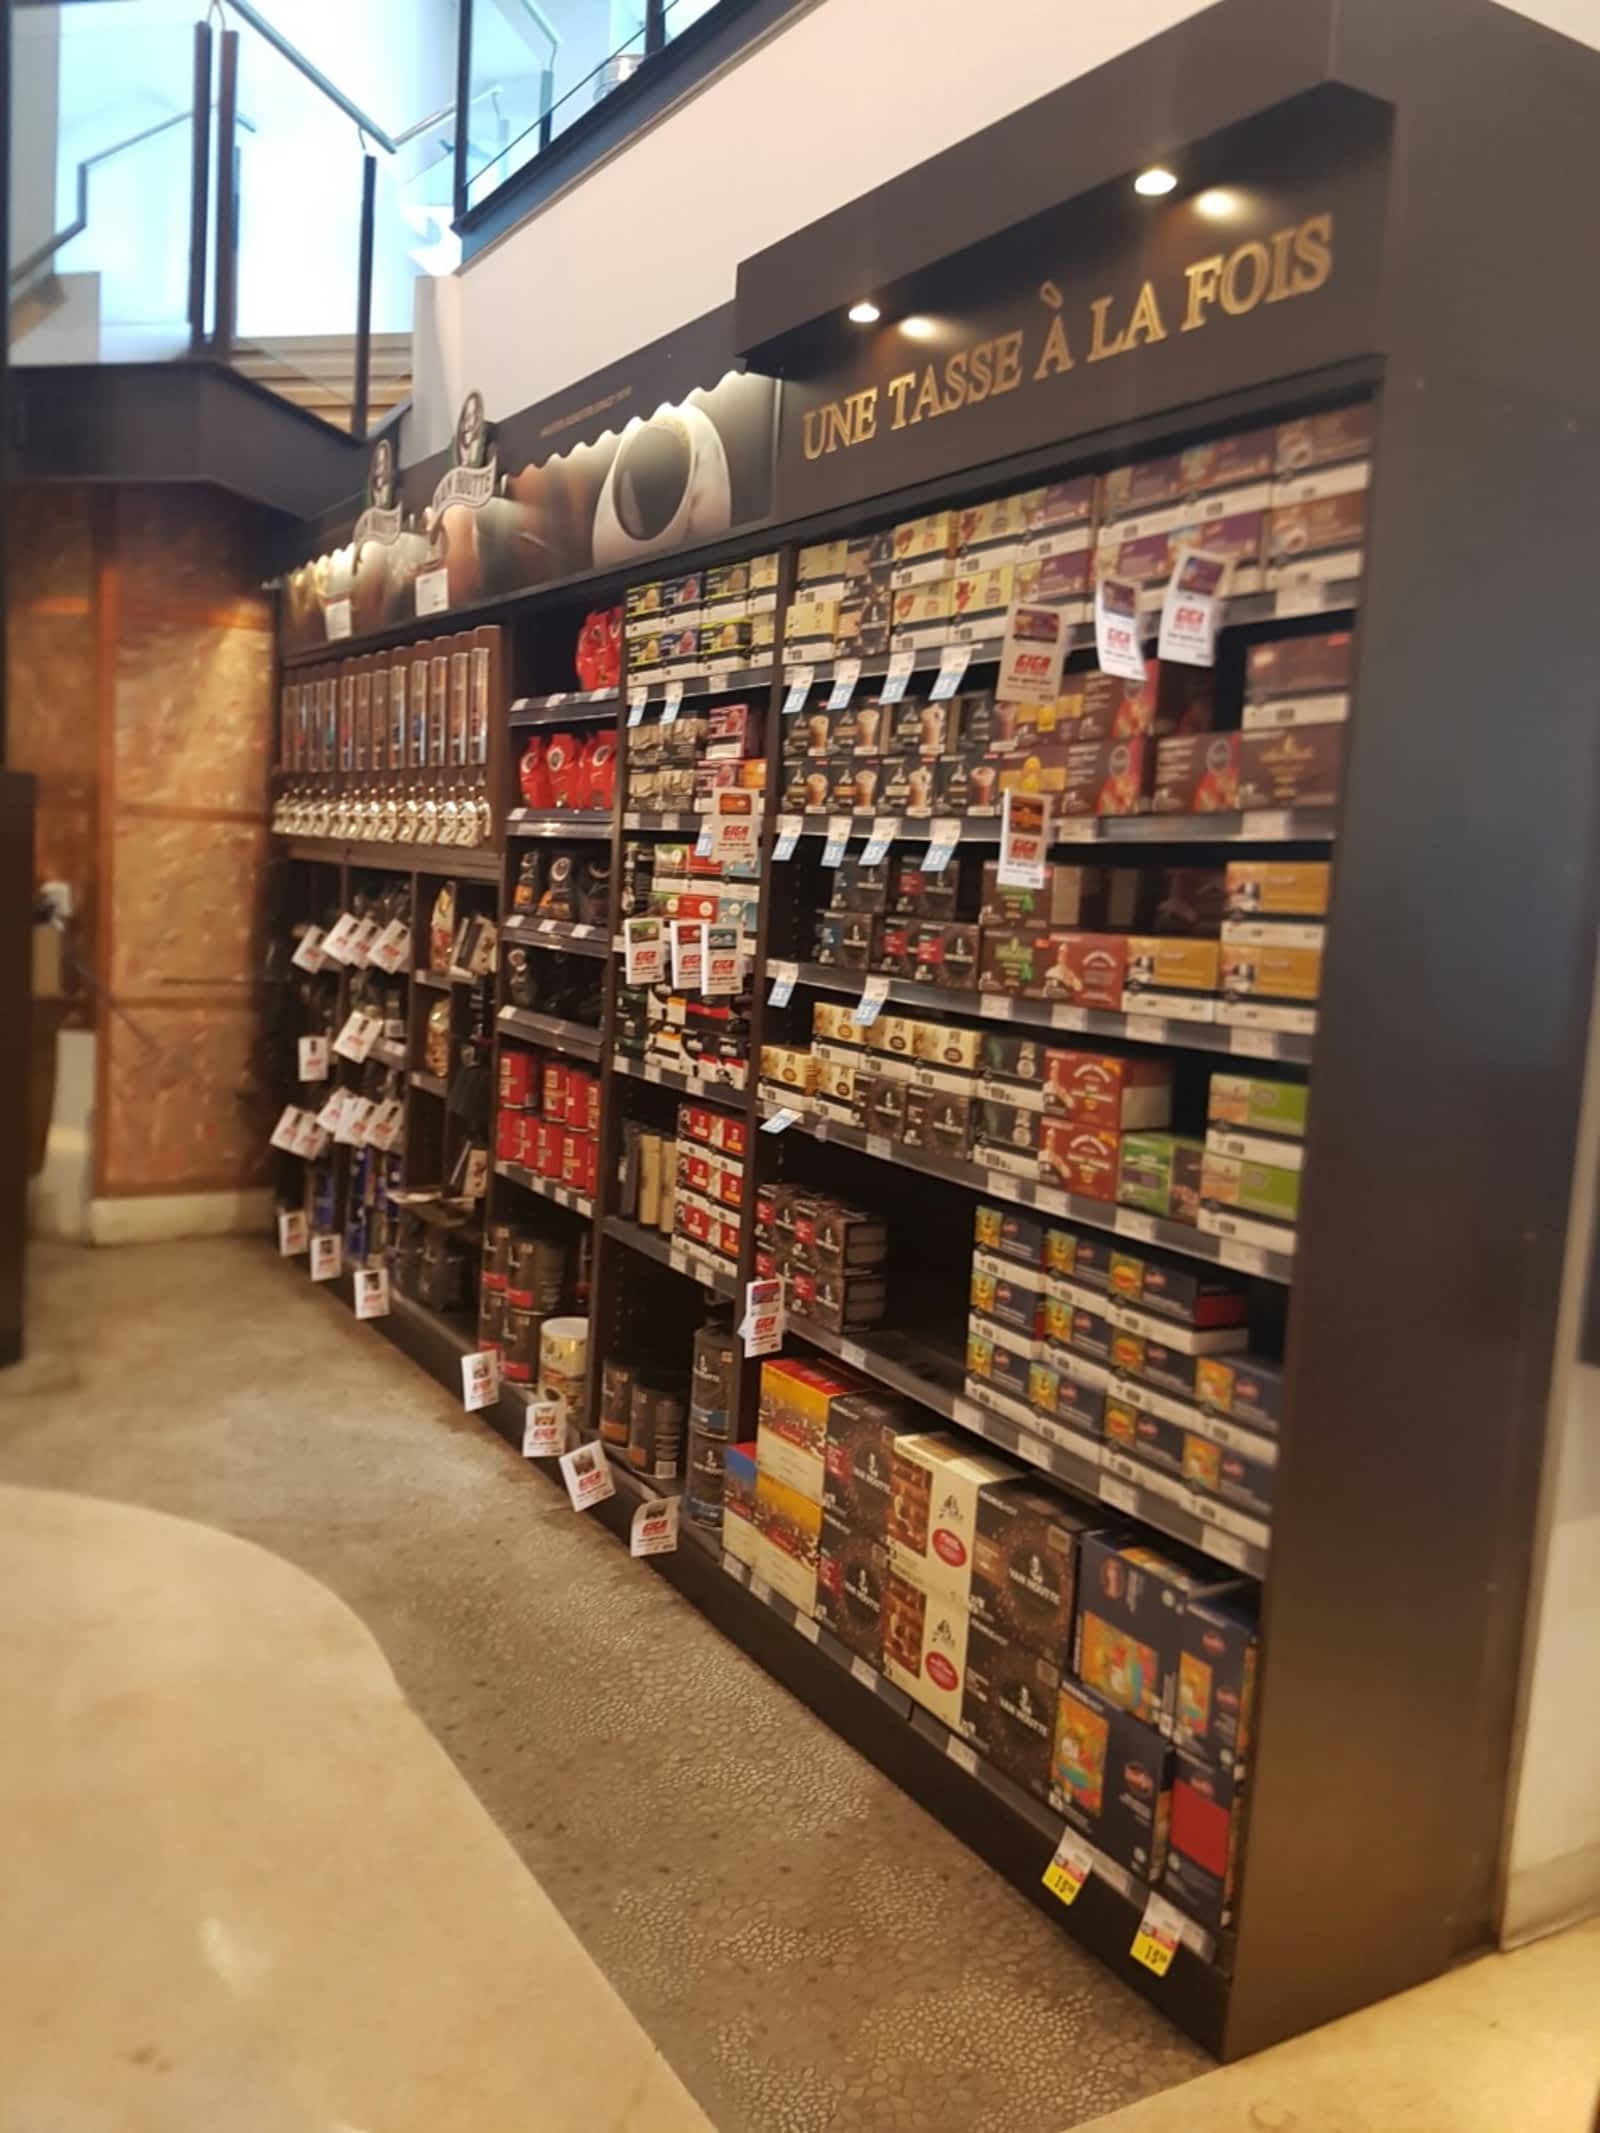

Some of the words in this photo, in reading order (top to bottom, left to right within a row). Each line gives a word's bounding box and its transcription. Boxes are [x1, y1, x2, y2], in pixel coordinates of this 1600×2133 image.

[803, 388, 878, 460] UNE
[888, 331, 1023, 430] TASSE
[1033, 280, 1074, 380] À
[1087, 282, 1167, 364] LA
[1181, 214, 1334, 332] FOIS
